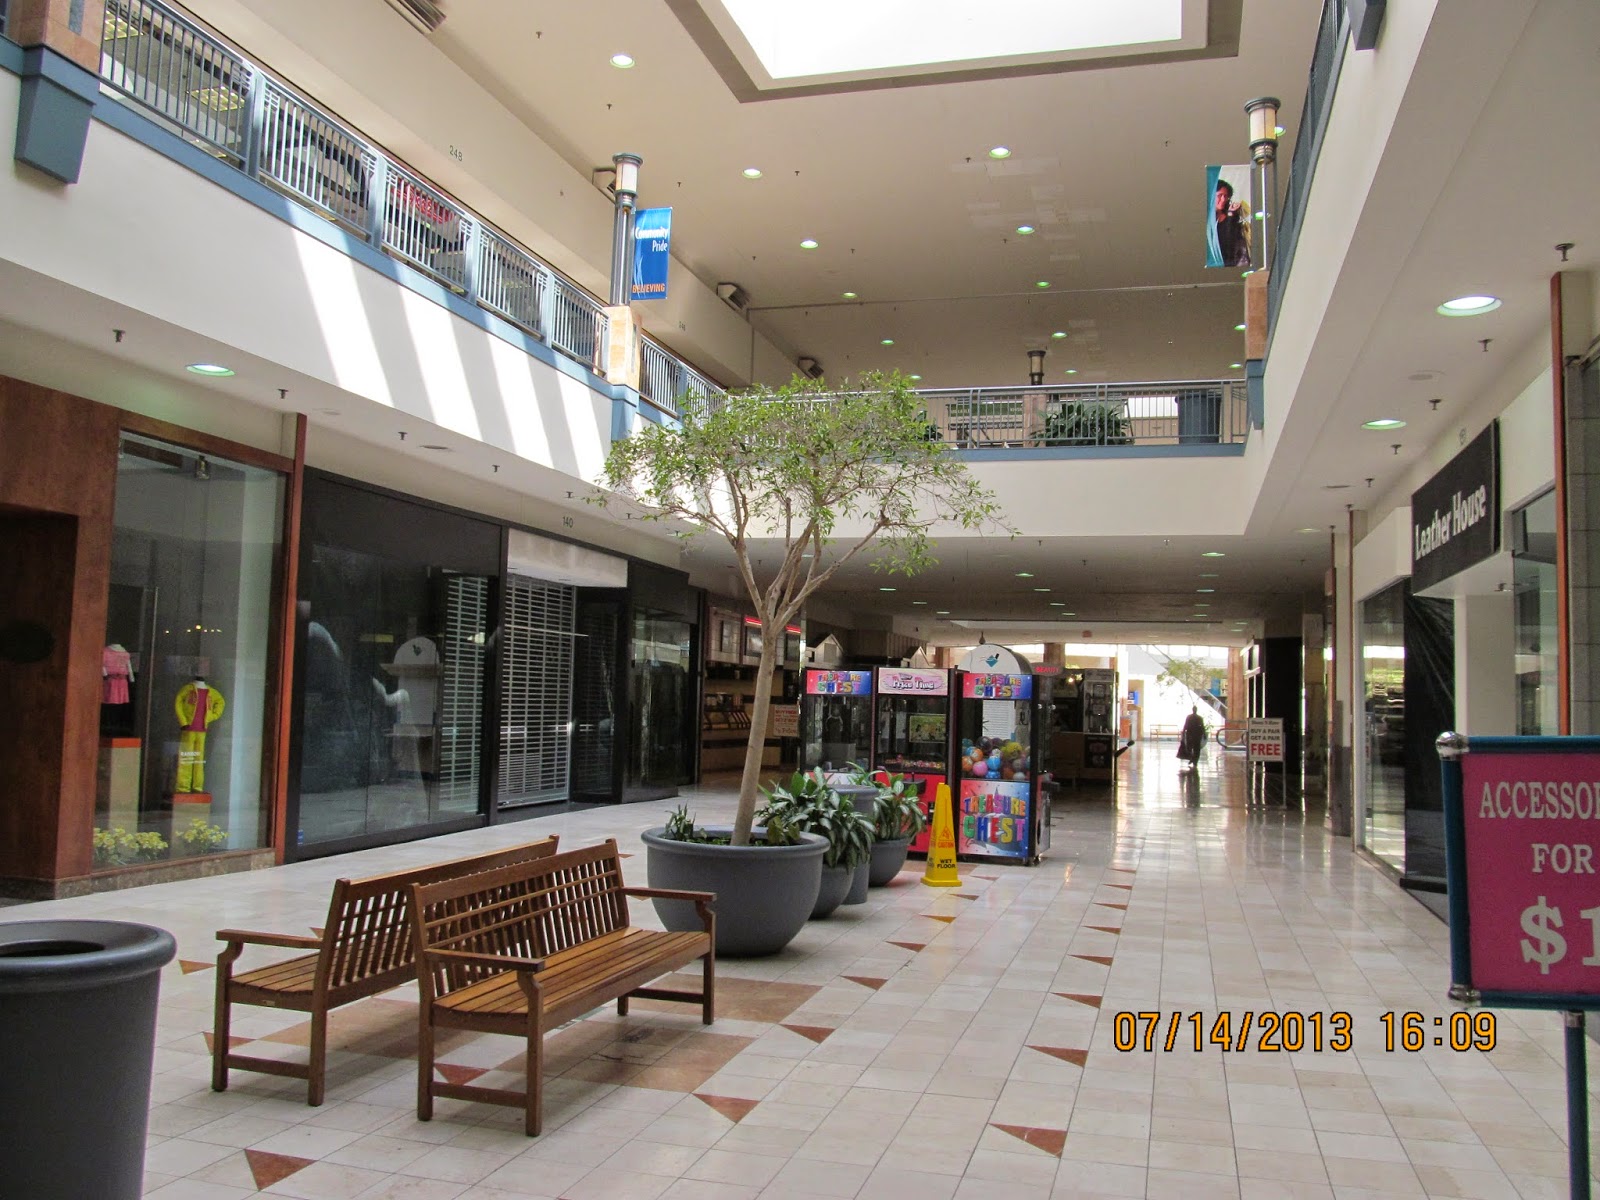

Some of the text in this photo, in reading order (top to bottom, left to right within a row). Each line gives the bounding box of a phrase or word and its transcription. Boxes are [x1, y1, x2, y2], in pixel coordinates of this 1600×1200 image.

[449, 144, 463, 162] 248
[635, 226, 668, 239] Community
[652, 240, 668, 252] Pride
[562, 516, 574, 528] 140
[1415, 484, 1487, 561] Leather House
[817, 681, 861, 693] CHEST
[975, 685, 1021, 697] CHEST
[1250, 743, 1281, 756] FREE
[963, 793, 1026, 817] TREASURE
[1479, 781, 1600, 820] ACCESSO
[963, 815, 1026, 844] CHEST
[1531, 843, 1596, 874] FOR
